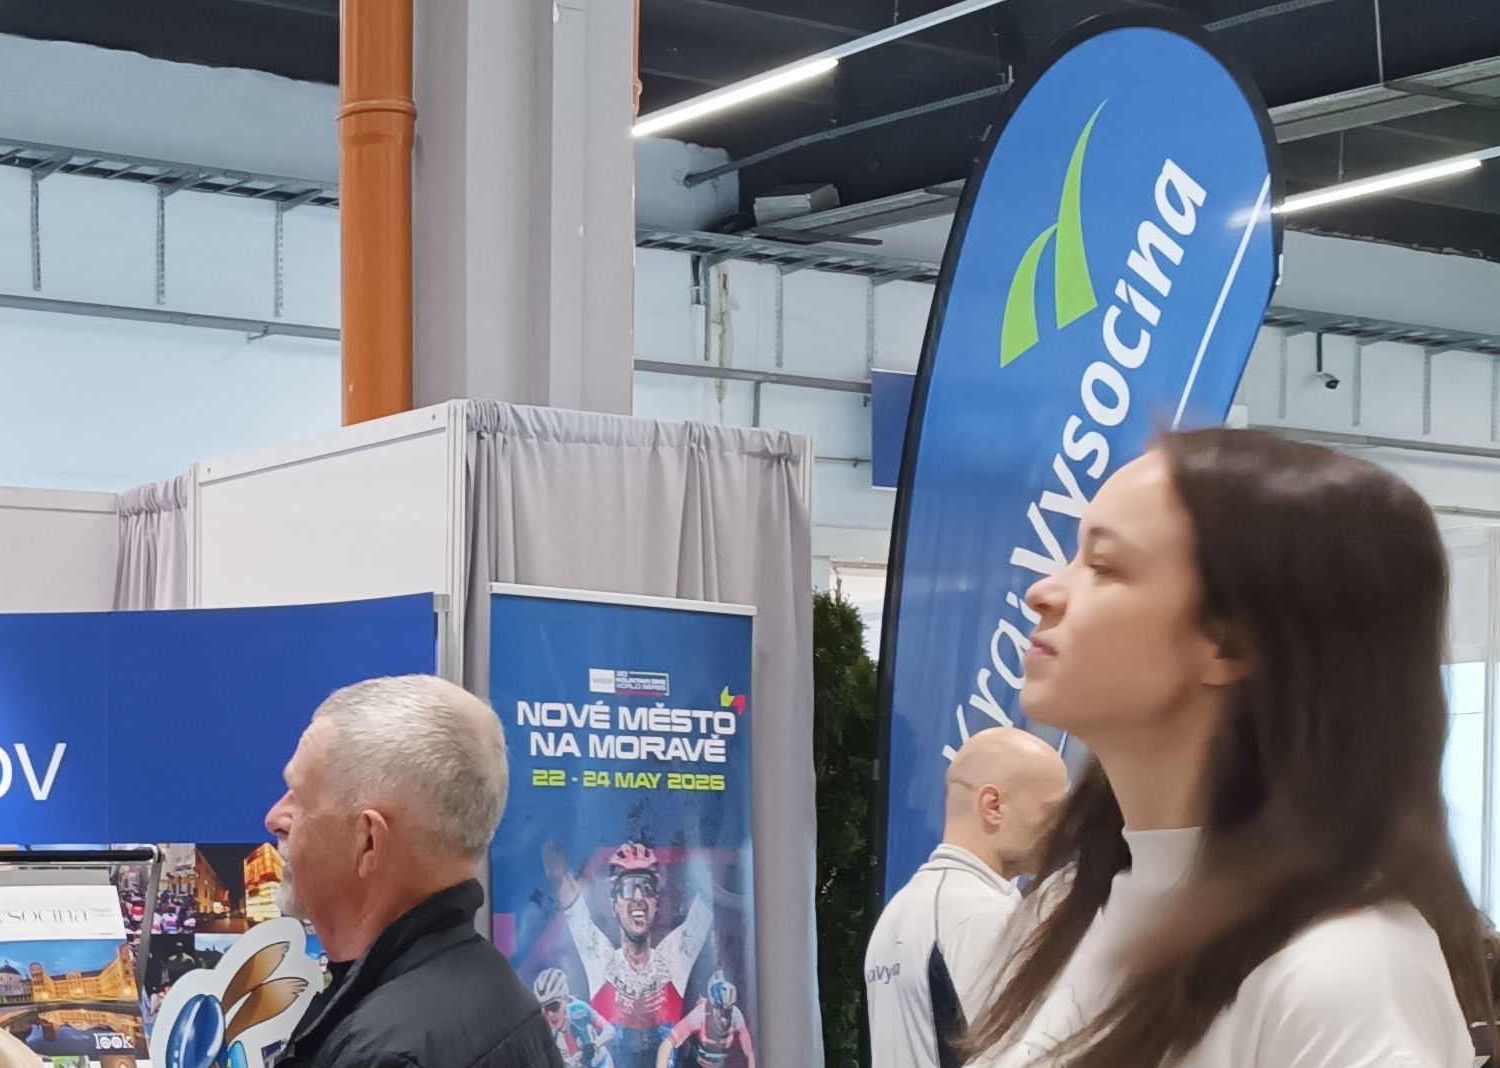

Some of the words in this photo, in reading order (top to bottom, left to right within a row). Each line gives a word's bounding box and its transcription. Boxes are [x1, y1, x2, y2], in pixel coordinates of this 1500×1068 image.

[517, 700, 611, 730] NOVÉ
[618, 702, 735, 735] MĚSTO
[530, 732, 581, 757] NA
[589, 734, 726, 762] MORAVĚ
[532, 769, 566, 787] 22
[583, 770, 610, 787] 24
[615, 772, 661, 788] MAY
[667, 774, 725, 790] 2026
